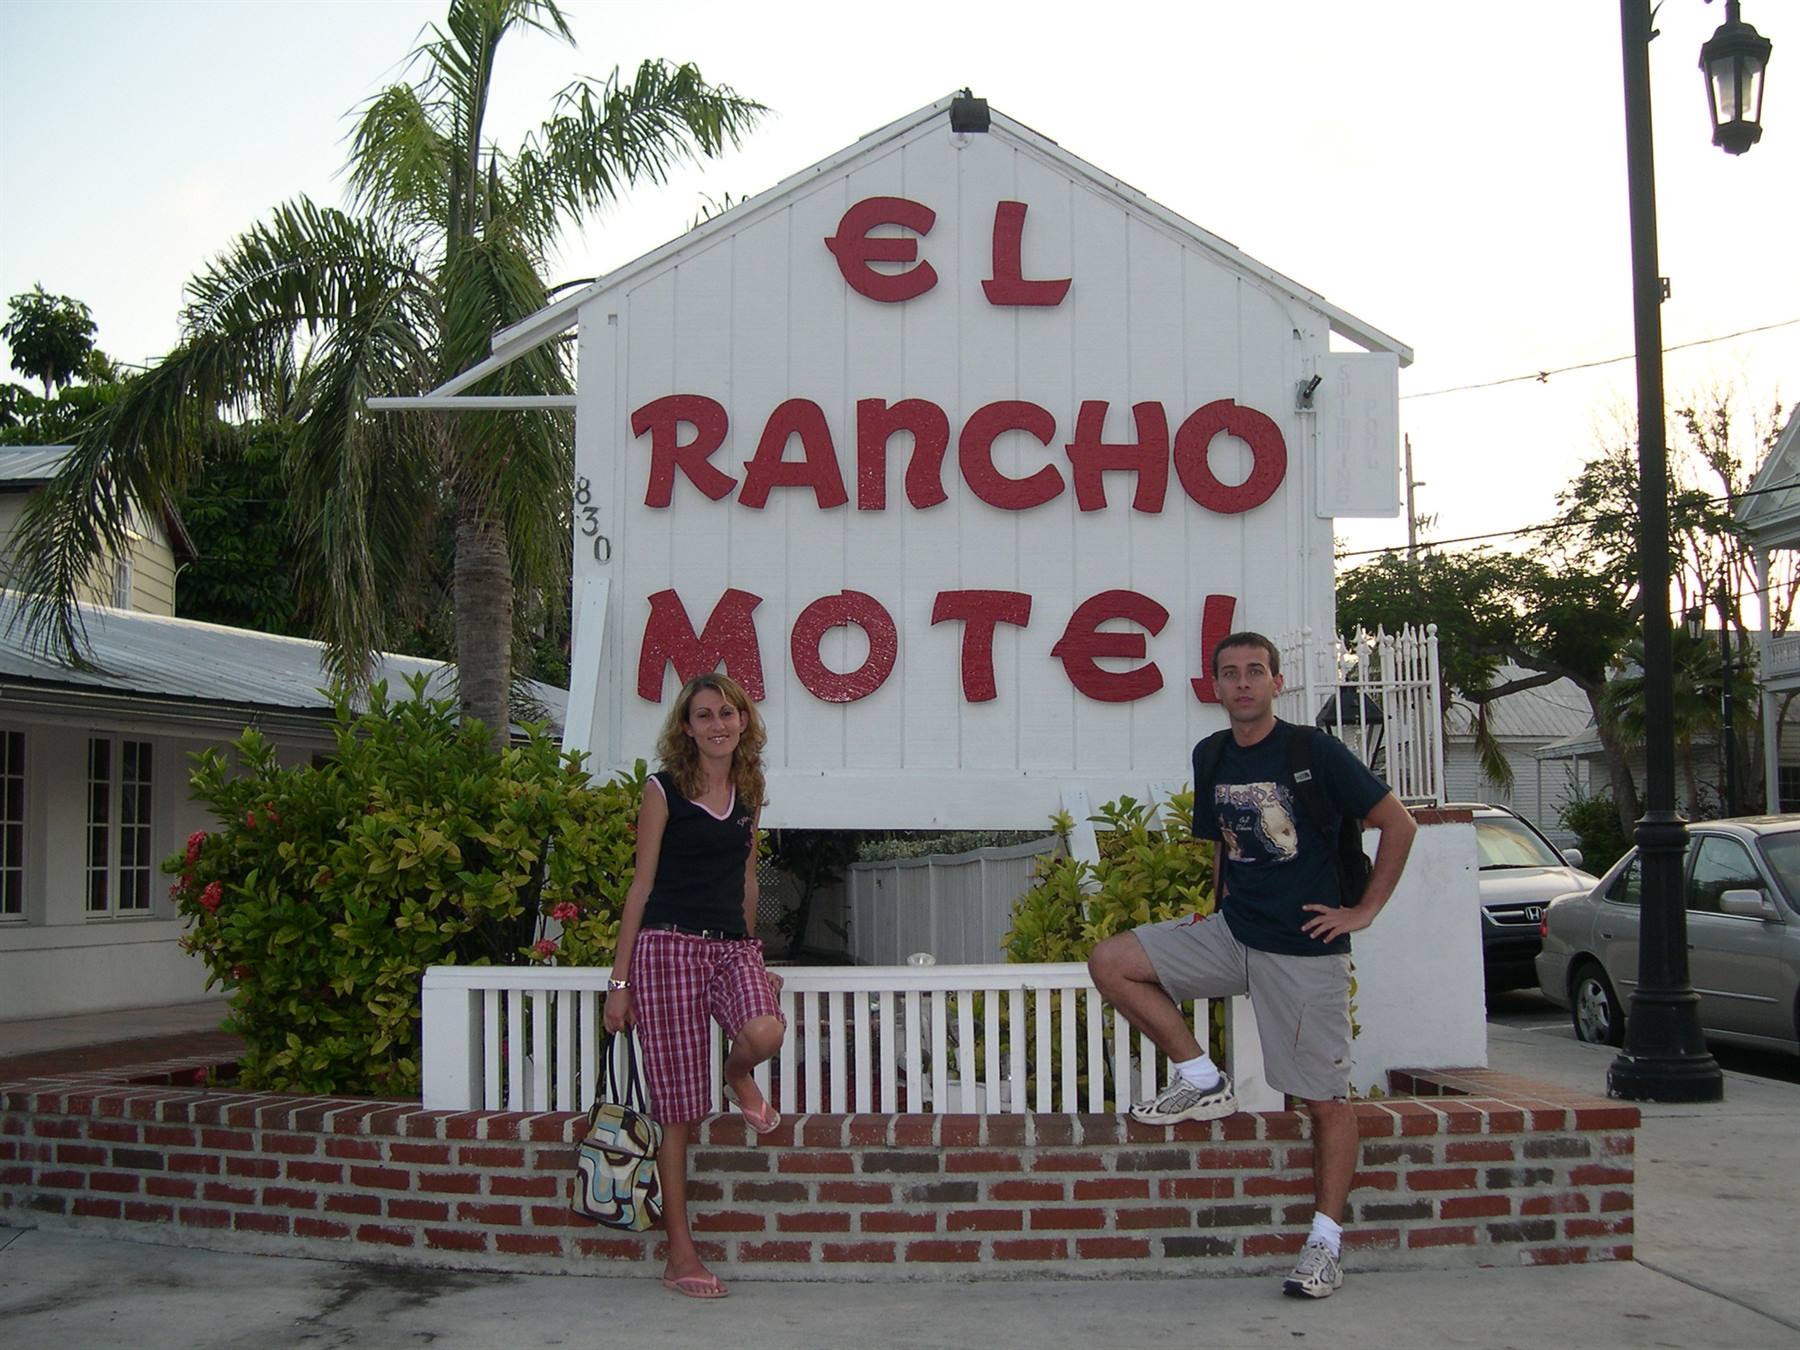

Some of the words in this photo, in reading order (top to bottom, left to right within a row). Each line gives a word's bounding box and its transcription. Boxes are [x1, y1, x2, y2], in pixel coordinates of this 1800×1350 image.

[824, 196, 1072, 306] EL
[631, 394, 1287, 514] RANCHO
[575, 476, 611, 565] 830
